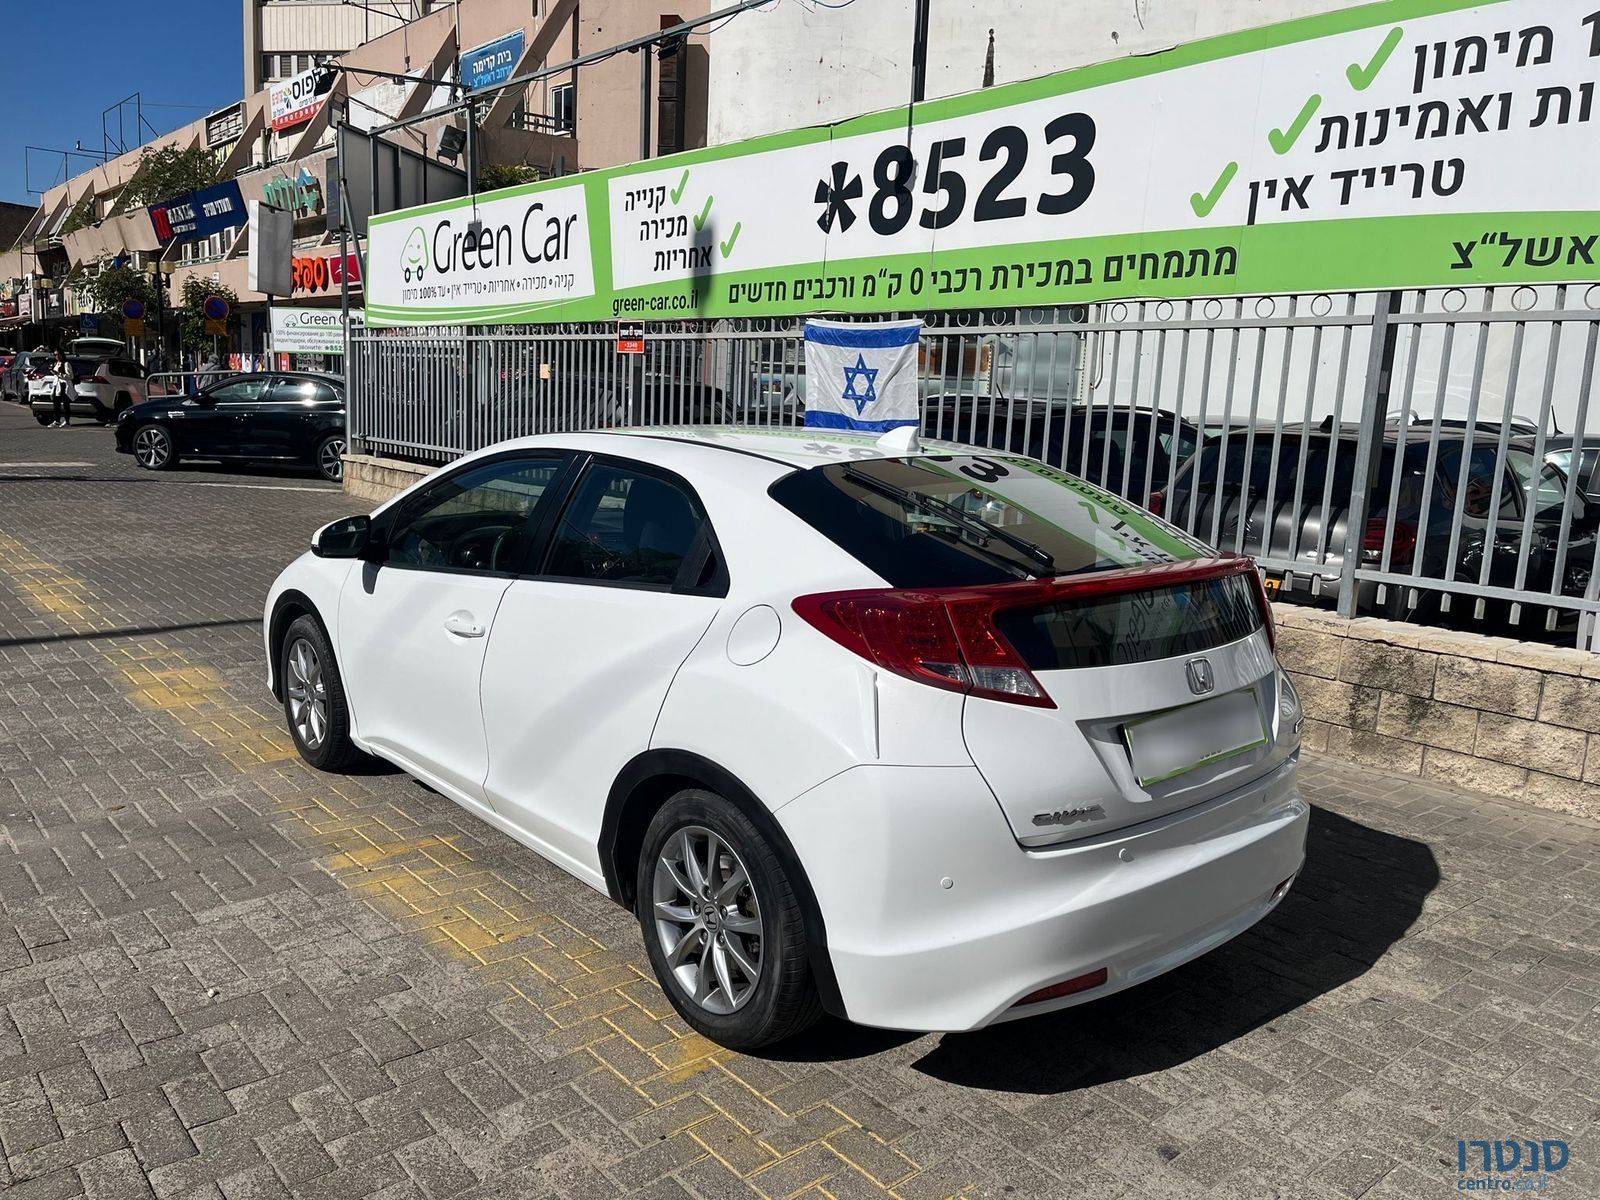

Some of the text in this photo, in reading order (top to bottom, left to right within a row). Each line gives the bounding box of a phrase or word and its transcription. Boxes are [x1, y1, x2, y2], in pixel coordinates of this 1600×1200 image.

[472, 50, 512, 75] בית קדימה
[1413, 25, 1553, 94] מימון
[1315, 92, 1513, 154] ואמינות
[624, 185, 666, 214] קנייה
[1247, 157, 1464, 225] טרייד אין
[433, 202, 577, 274] Green Car
[639, 215, 688, 241] מכירה
[653, 245, 713, 272] אחריות
[1103, 246, 1238, 282] מתמחים
[487, 278, 516, 294] אחריות
[521, 275, 547, 291] מכירה
[554, 273, 575, 293] קניה
[909, 267, 924, 295] 0
[931, 267, 982, 294] רכבי
[989, 258, 1093, 290] במכירת
[402, 288, 418, 304] מימון
[419, 287, 437, 299] 100%
[451, 284, 461, 300] אין
[462, 281, 482, 295] טרייד
[728, 281, 787, 303] חדשים
[793, 276, 855, 300] ורכבים
[612, 289, 699, 316] green-car.co.il
[300, 312, 336, 325] Green
